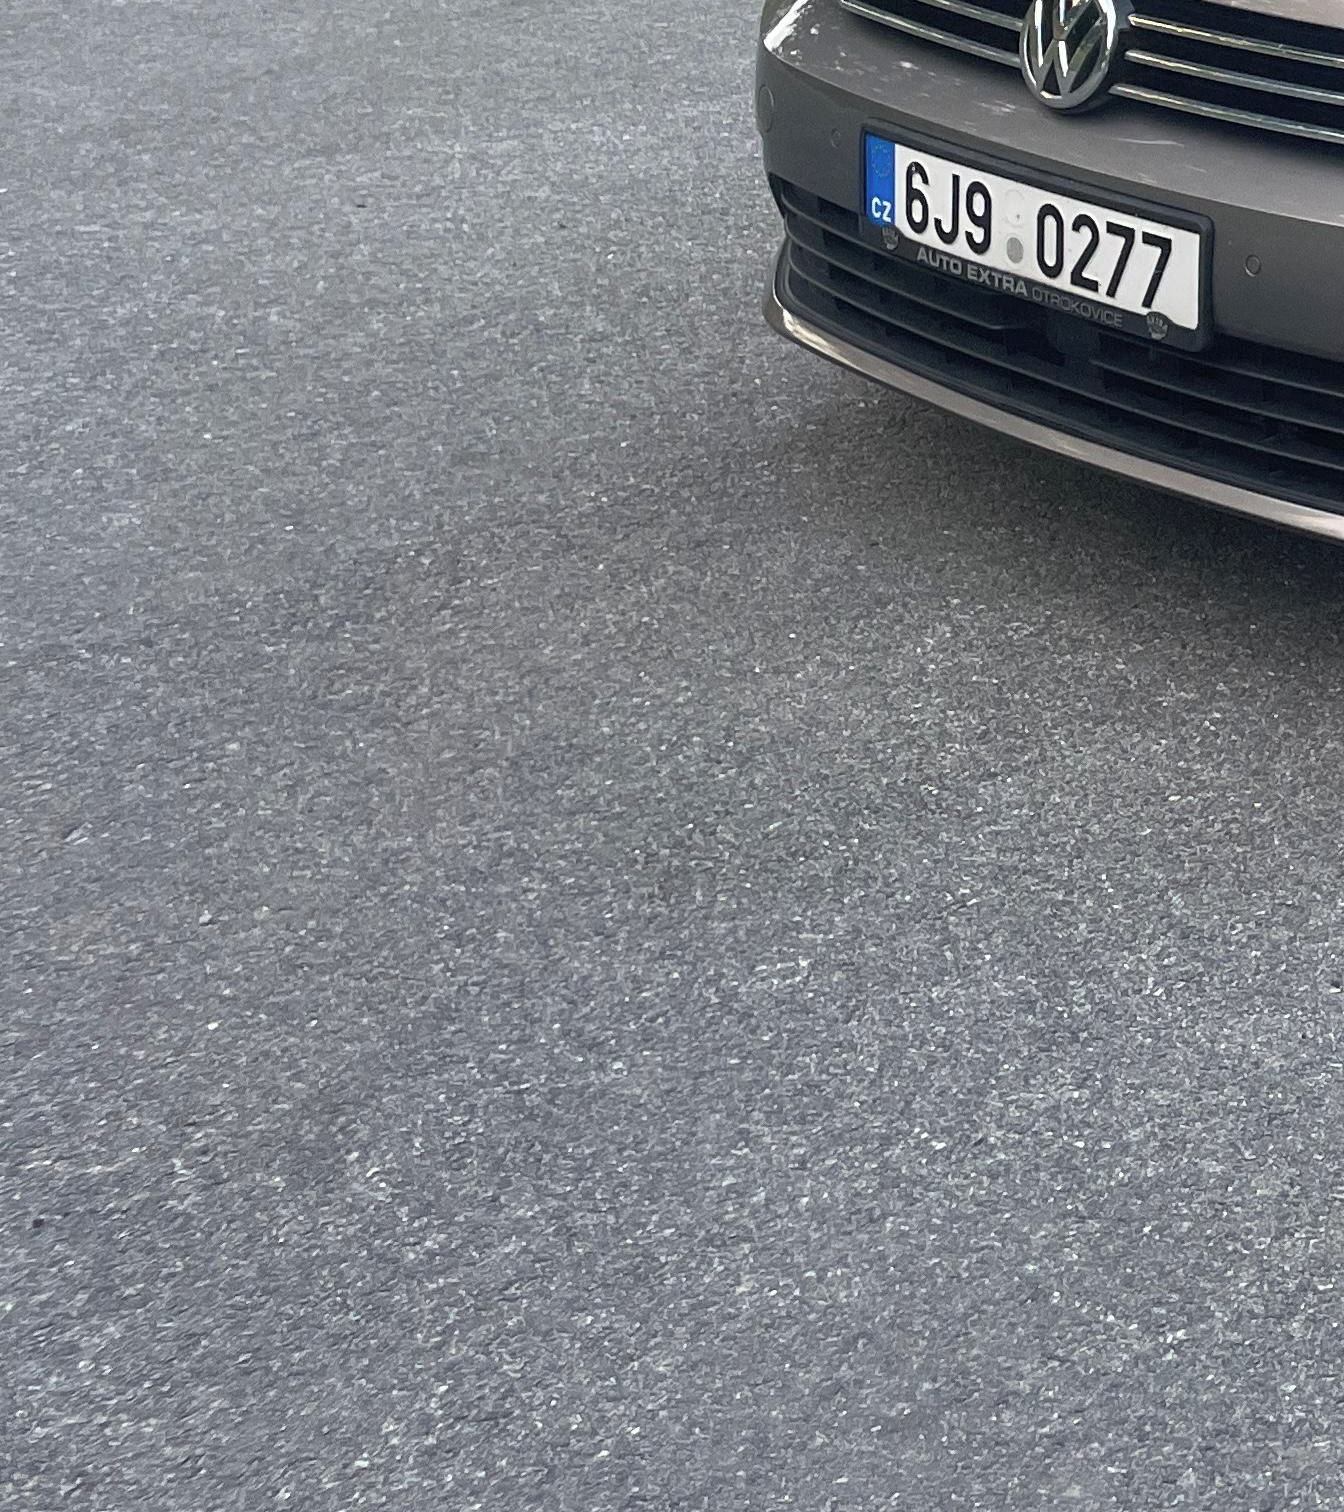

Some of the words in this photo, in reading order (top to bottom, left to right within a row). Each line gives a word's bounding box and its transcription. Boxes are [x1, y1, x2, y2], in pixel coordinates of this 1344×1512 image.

[871, 196, 892, 223] CZ
[904, 160, 992, 255] 6J9
[1036, 203, 1173, 309] 0277
[916, 246, 962, 276] AUTO
[966, 265, 1028, 297] EXTRA
[1032, 287, 1124, 329] OTROKOVICE
